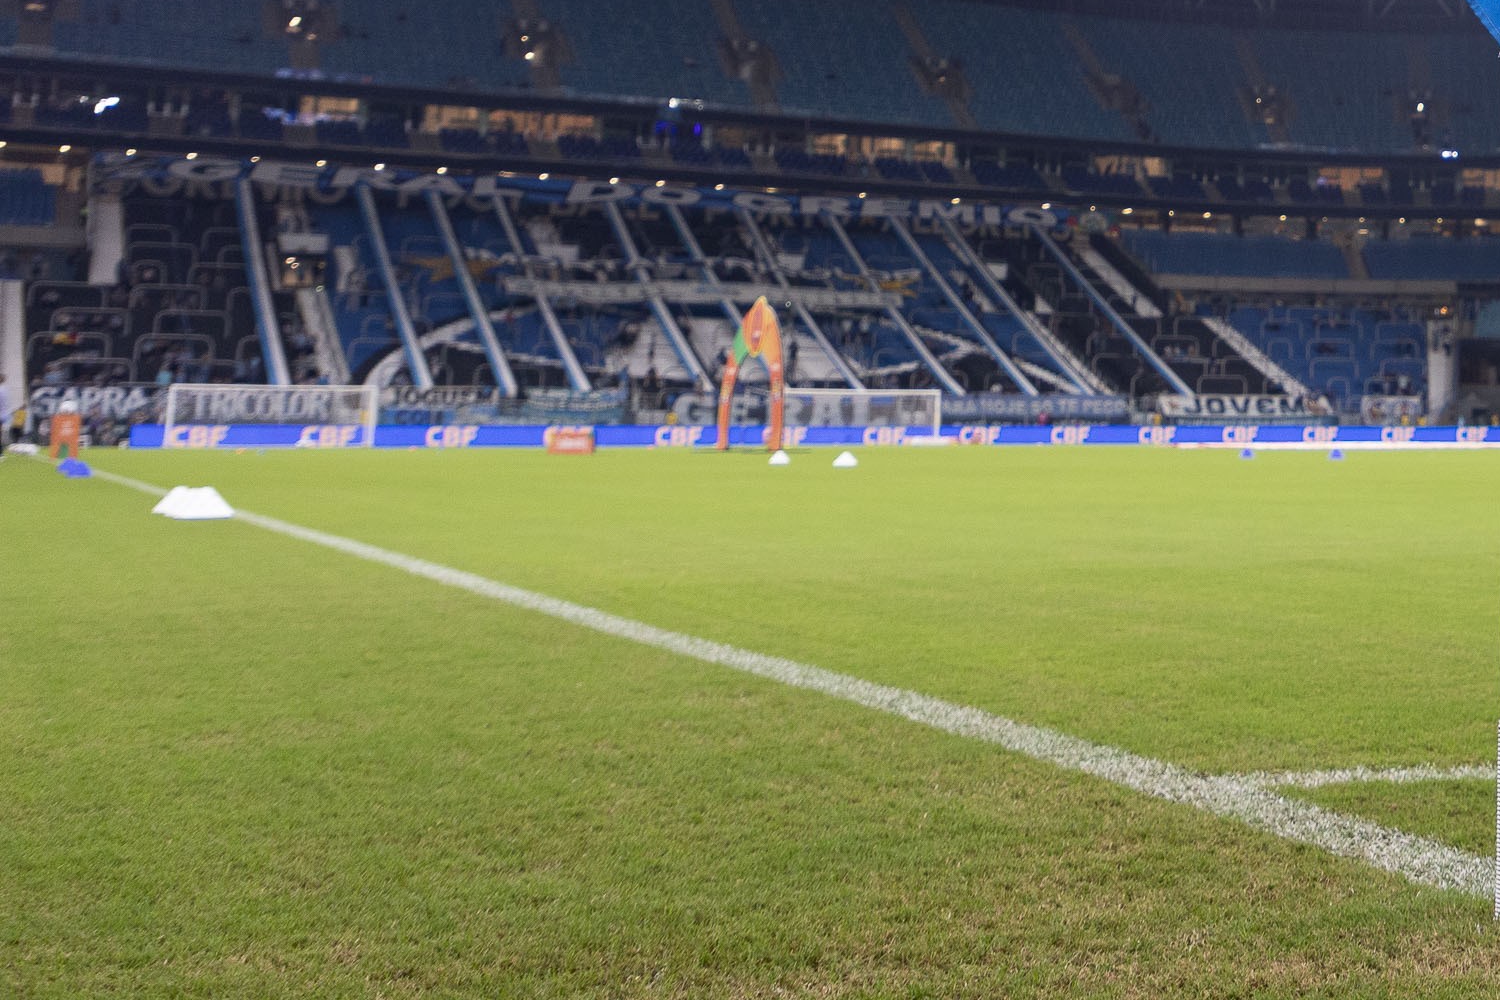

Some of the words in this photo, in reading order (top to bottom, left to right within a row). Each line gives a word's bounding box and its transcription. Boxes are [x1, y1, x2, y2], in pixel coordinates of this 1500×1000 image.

[166, 425, 230, 447] CBF
[301, 425, 361, 447] CBF
[425, 425, 480, 448] CBF
[654, 426, 704, 446] CBF
[1051, 426, 1091, 444] CBF
[1138, 426, 1177, 444] CBF
[1222, 426, 1260, 443] CBF
[1303, 426, 1339, 443] CBF
[1381, 426, 1416, 443] CBF
